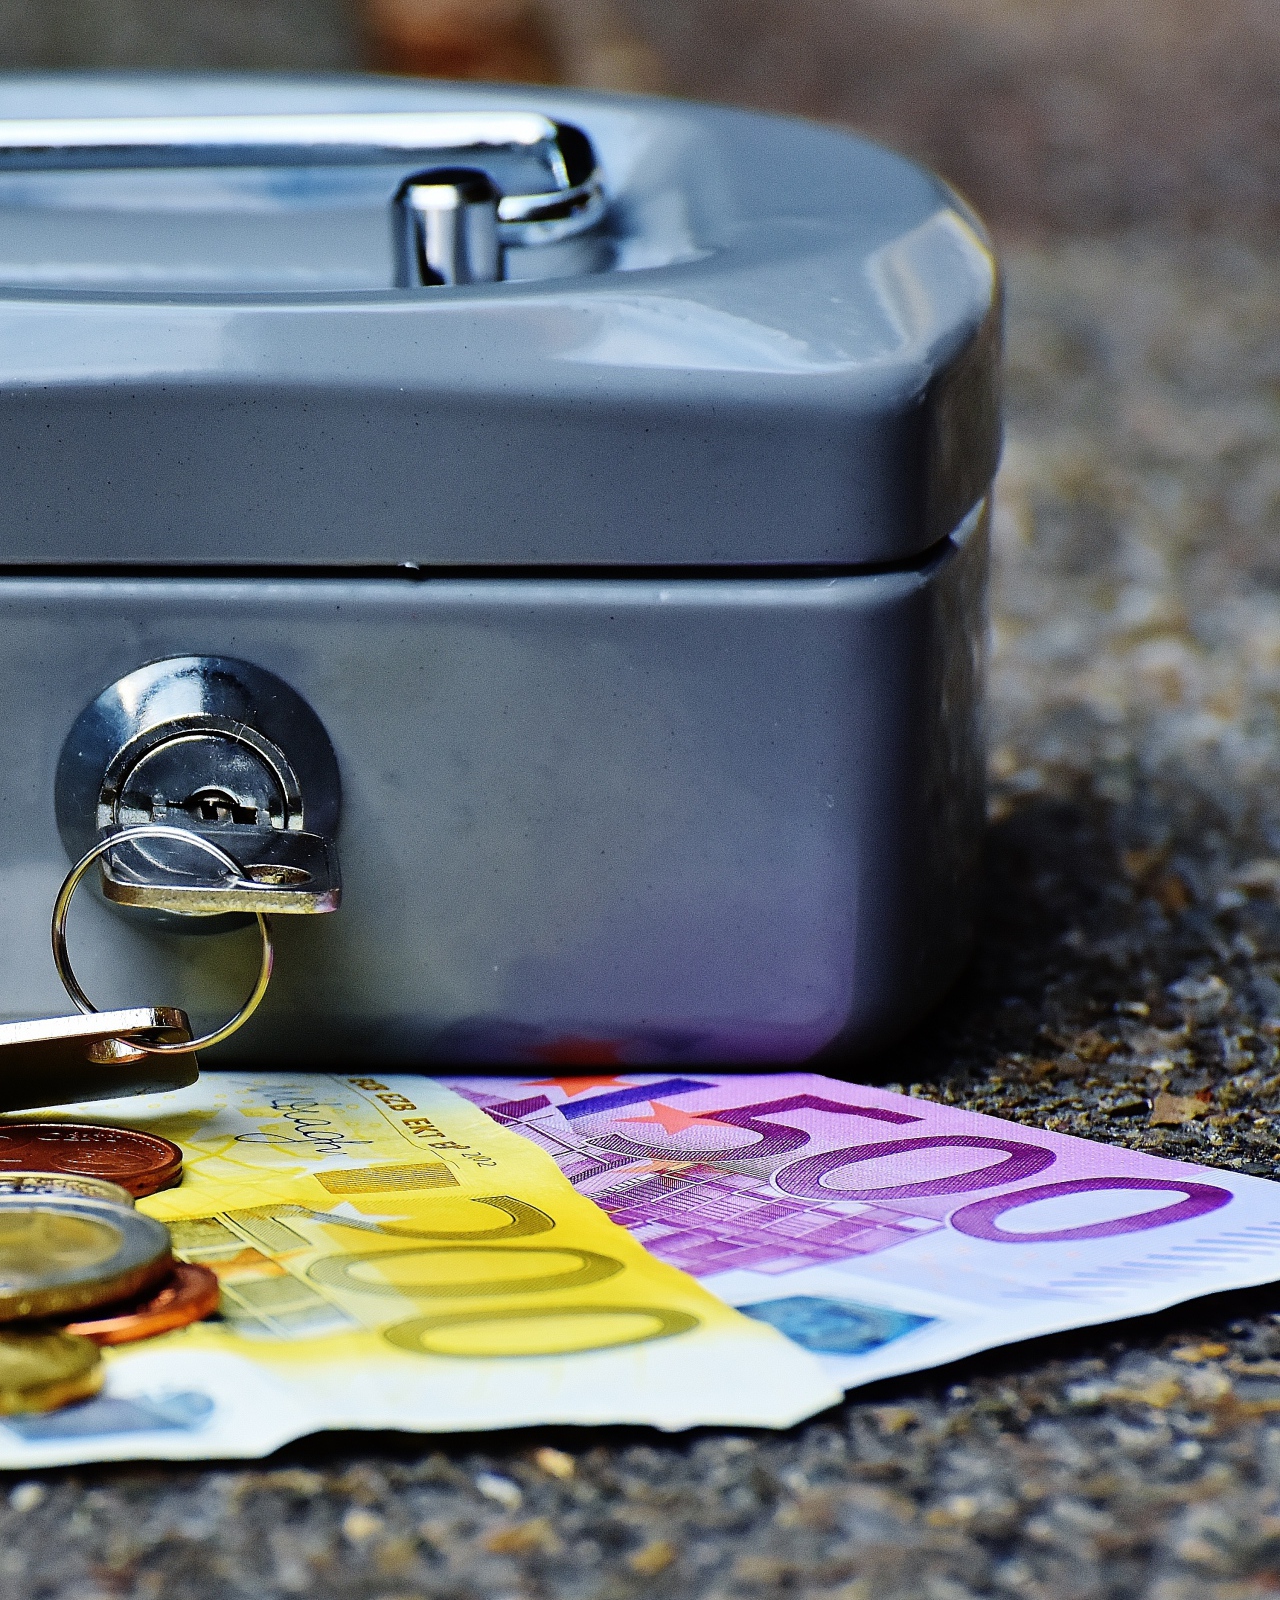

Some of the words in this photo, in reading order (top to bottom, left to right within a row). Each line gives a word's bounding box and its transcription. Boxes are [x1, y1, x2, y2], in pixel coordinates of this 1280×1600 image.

[375, 1093, 417, 1111] EZB
[402, 1117, 447, 1138] EKT
[582, 1094, 1234, 1243] 500
[222, 1195, 701, 1357] 200
